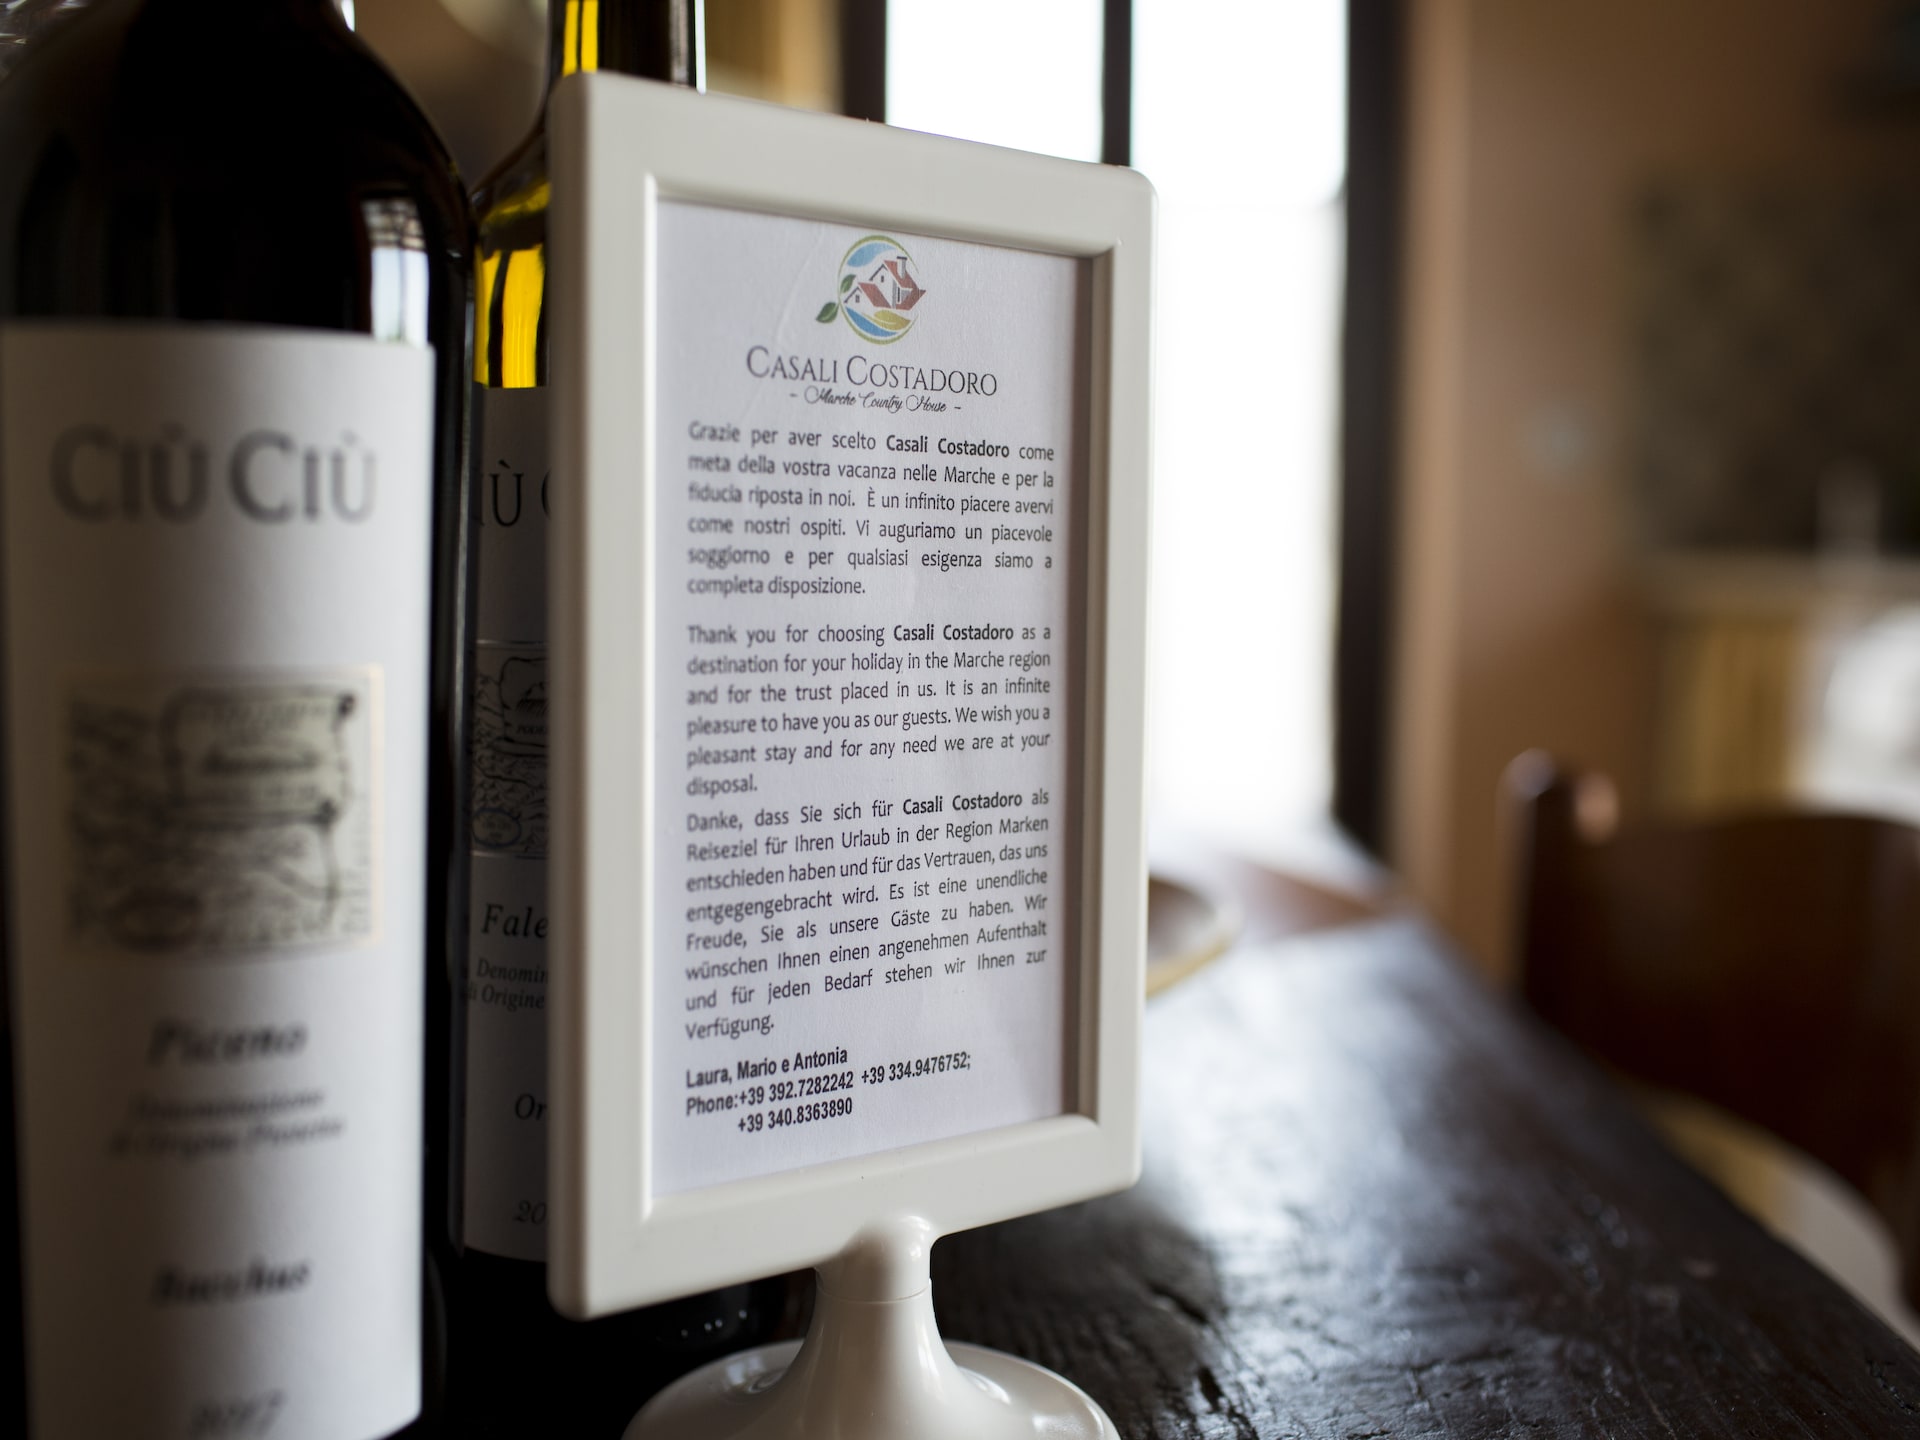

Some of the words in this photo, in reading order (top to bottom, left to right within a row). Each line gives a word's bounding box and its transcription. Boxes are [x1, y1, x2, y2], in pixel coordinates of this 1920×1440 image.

[747, 345, 837, 383] CASALI
[847, 355, 997, 396] COSTADORO
[804, 386, 856, 406] Marche
[858, 391, 903, 414] Country
[906, 394, 947, 412] House
[688, 421, 740, 442] Grazie
[751, 429, 778, 448] per
[788, 432, 822, 447] aver
[832, 431, 876, 450] scelto
[886, 434, 928, 453] Casali
[938, 438, 1010, 458] Costadoro
[1019, 446, 1054, 461] come
[49, 422, 209, 526] CIÙ
[227, 428, 377, 526] CIÙ
[688, 456, 731, 472] meta
[738, 454, 775, 474] della
[782, 460, 830, 477] vostra
[838, 464, 896, 480] vacanza
[904, 464, 937, 482] nelle
[944, 466, 996, 485] Marche
[1016, 474, 1038, 491] per
[688, 483, 742, 503] fiducia
[749, 486, 803, 508] riposta
[809, 488, 822, 506] in
[828, 490, 855, 507] noi.
[868, 486, 876, 508] È
[905, 491, 955, 511] infinito
[961, 494, 1010, 516] piacere
[1014, 499, 1053, 514] avervi
[688, 518, 734, 534] come
[744, 516, 790, 534] nostri
[800, 518, 846, 540] ospiti.
[856, 520, 870, 536] Vi
[879, 521, 956, 544] auguriamo
[992, 524, 1052, 544] piacevole
[688, 546, 770, 570] soggiorno
[808, 551, 834, 570] per
[848, 548, 908, 570] qualsiasi
[921, 550, 982, 572] esigenza
[994, 552, 1033, 568] siamo
[687, 575, 764, 598] completa
[768, 576, 866, 599] disposizione.
[688, 625, 737, 644] Thank
[746, 629, 776, 648] you
[785, 624, 809, 643] for
[818, 624, 885, 647] choosing
[893, 623, 934, 642] Casali
[943, 623, 1014, 640] Costadoro
[687, 655, 778, 674] destination
[784, 653, 807, 672] for
[812, 658, 846, 676] your
[852, 652, 903, 674] holiday
[908, 652, 920, 669] in
[925, 651, 948, 669] the
[954, 650, 1004, 668] Marche
[1009, 650, 1050, 672] region
[687, 686, 718, 705] and
[728, 684, 752, 704] for
[760, 684, 786, 702] the
[795, 684, 832, 701] trust
[841, 680, 888, 704] placed
[897, 681, 909, 698] in
[918, 684, 936, 697] us.
[981, 682, 998, 695] an
[1005, 676, 1050, 694] infinite
[687, 716, 757, 740] pleasure
[782, 712, 819, 731] have
[822, 716, 850, 734] you
[874, 713, 899, 727] our
[902, 708, 951, 732] guests.
[955, 707, 978, 723] We
[981, 704, 1012, 722] wish
[1016, 708, 1039, 725] you
[687, 746, 756, 769] pleasant
[765, 745, 797, 765] stay
[804, 740, 832, 759] and
[840, 739, 863, 757] for
[870, 742, 896, 759] any
[903, 734, 936, 754] need
[944, 738, 965, 752] we
[972, 736, 994, 750] are
[1021, 734, 1050, 752] your
[686, 773, 758, 799] disposal.
[687, 811, 743, 832] Danke,
[754, 808, 789, 827] dass
[800, 805, 822, 824] Sie
[833, 801, 861, 821] sich
[872, 800, 894, 818] für
[902, 795, 943, 815] Casali
[952, 792, 1023, 812] Costadoro
[1032, 788, 1049, 805] als
[687, 838, 757, 861] Reiseziel
[764, 836, 788, 855] für
[795, 834, 834, 852] Ihren
[842, 827, 890, 848] Urlaub
[896, 827, 909, 844] in
[916, 824, 940, 842] der
[946, 820, 992, 843] Region
[999, 816, 1048, 834] Marken
[686, 867, 784, 892] entschieden
[789, 862, 836, 882] haben
[840, 857, 868, 877] und
[872, 856, 894, 874] für
[896, 854, 920, 872] das
[924, 850, 995, 868] Vertrauen,
[999, 844, 1022, 861] das
[1026, 845, 1048, 859] uns
[686, 890, 832, 925] entgegengebracht
[842, 884, 878, 905] wird.
[914, 880, 930, 898] ist
[938, 877, 967, 894] eine
[976, 868, 1048, 890] unendliche
[686, 930, 747, 951] Freude,
[761, 924, 784, 944] Sie
[796, 920, 816, 939] als
[830, 917, 878, 935] unsere
[890, 908, 930, 927] Gäste
[969, 900, 1014, 918] haben.
[1024, 894, 1048, 910] Wir
[686, 956, 768, 980] wünschen
[778, 952, 820, 970] Ihnen
[829, 945, 870, 964] einen
[878, 933, 968, 960] angenehmen
[976, 920, 1046, 944] Aufenthalt
[482, 984, 544, 1012] Origine
[686, 989, 717, 1011] und
[731, 986, 755, 1005] für
[768, 980, 810, 1005] jeden
[824, 968, 873, 992] Bedarf
[885, 963, 932, 984] stehen
[944, 957, 966, 974] wir
[978, 953, 1014, 970] Ihnen
[1026, 950, 1047, 964] zur
[685, 1014, 774, 1040] Verfügung.
[686, 1068, 732, 1089] Laura,
[737, 1057, 777, 1080] Mario
[793, 1046, 848, 1072] Antonia
[768, 1070, 854, 1102] 392.7282242
[861, 1065, 885, 1085] +39
[888, 1051, 971, 1082] 334.9476752;
[738, 1112, 763, 1133] +39
[768, 1098, 853, 1131] 340.8363890
